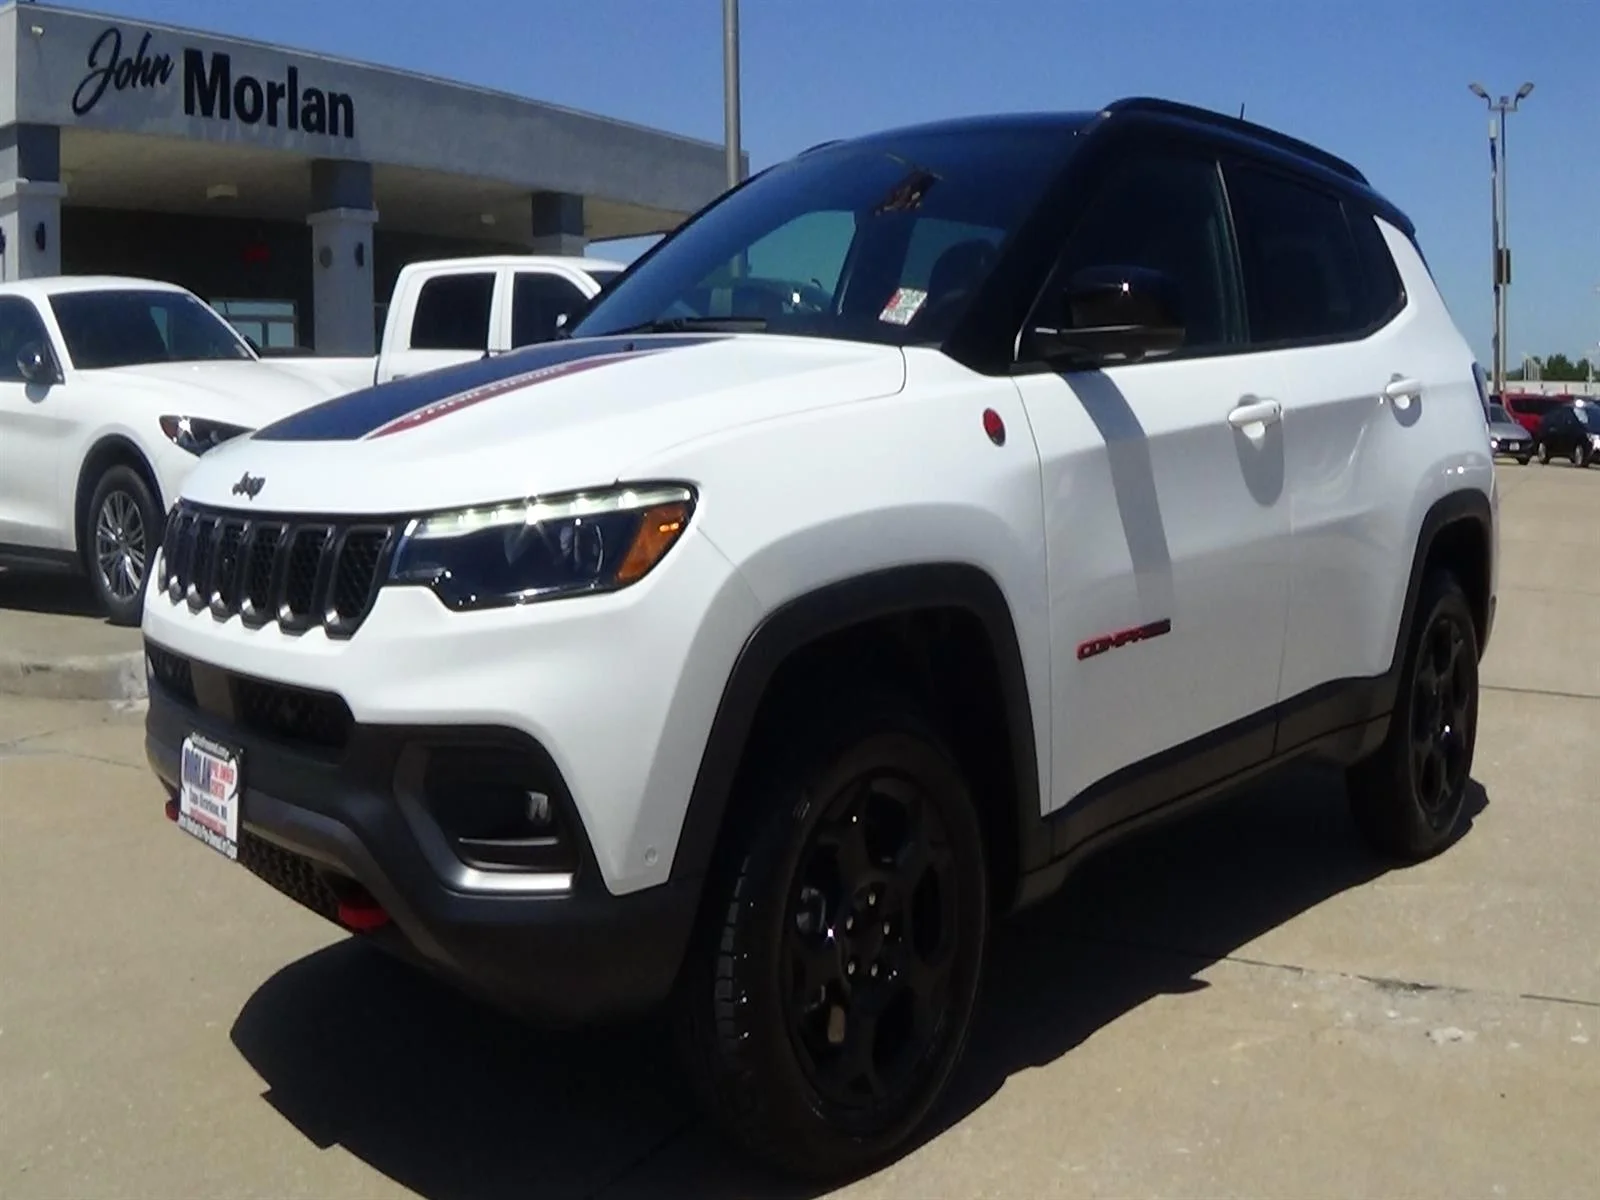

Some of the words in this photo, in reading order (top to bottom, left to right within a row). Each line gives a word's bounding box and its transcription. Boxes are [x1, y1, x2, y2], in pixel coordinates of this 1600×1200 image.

[72, 27, 174, 116] John
[183, 47, 354, 138] Morlan
[1077, 618, 1171, 661] COMPA
